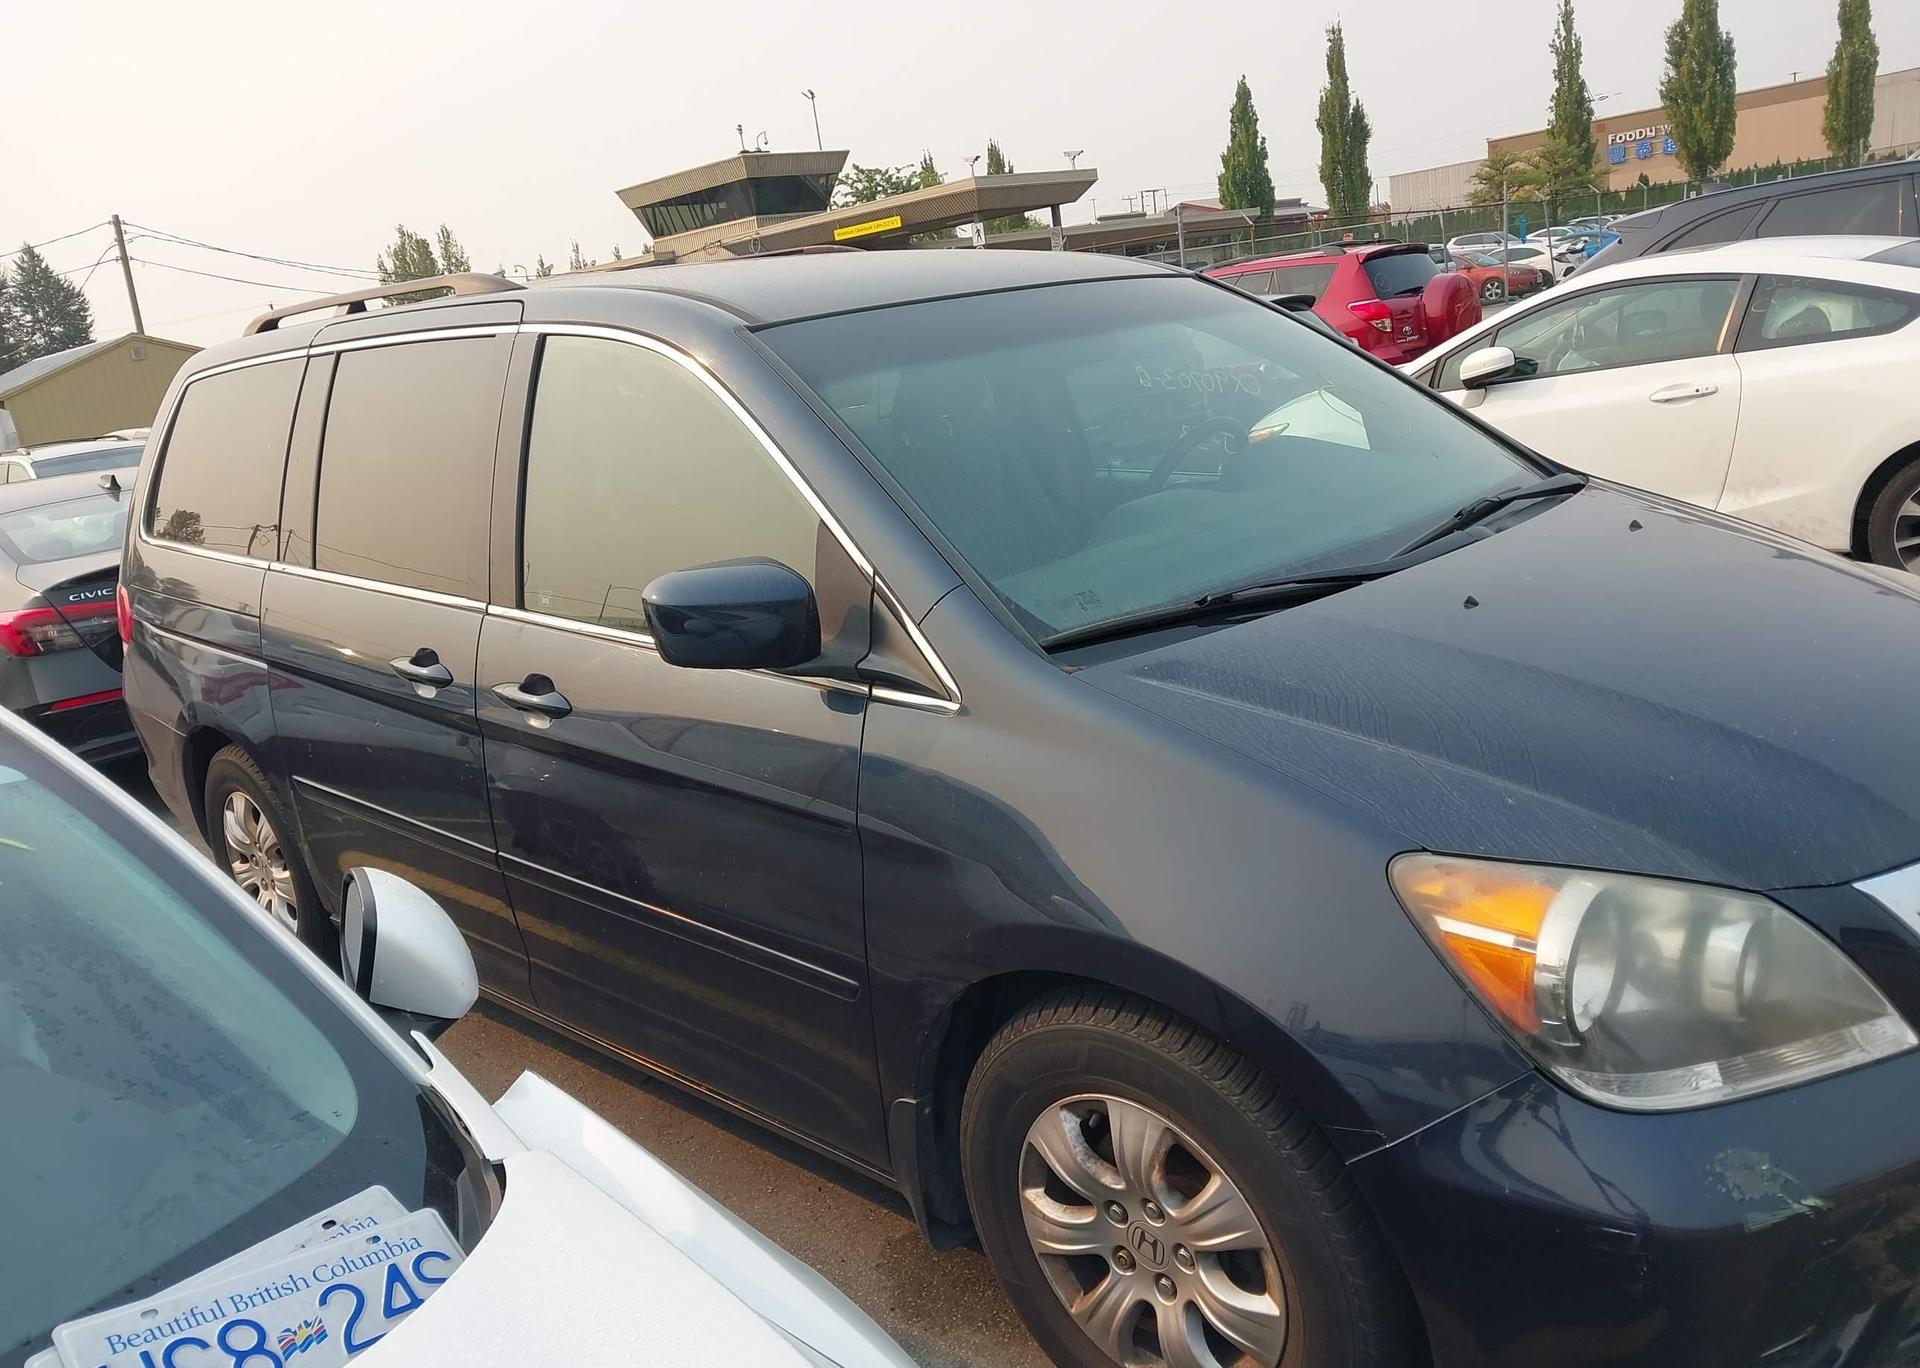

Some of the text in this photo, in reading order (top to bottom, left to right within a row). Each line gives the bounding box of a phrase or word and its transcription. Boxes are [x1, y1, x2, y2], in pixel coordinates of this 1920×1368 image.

[69, 588, 113, 601] CIVIC
[105, 1236, 424, 1356] Beautiful British Columbia
